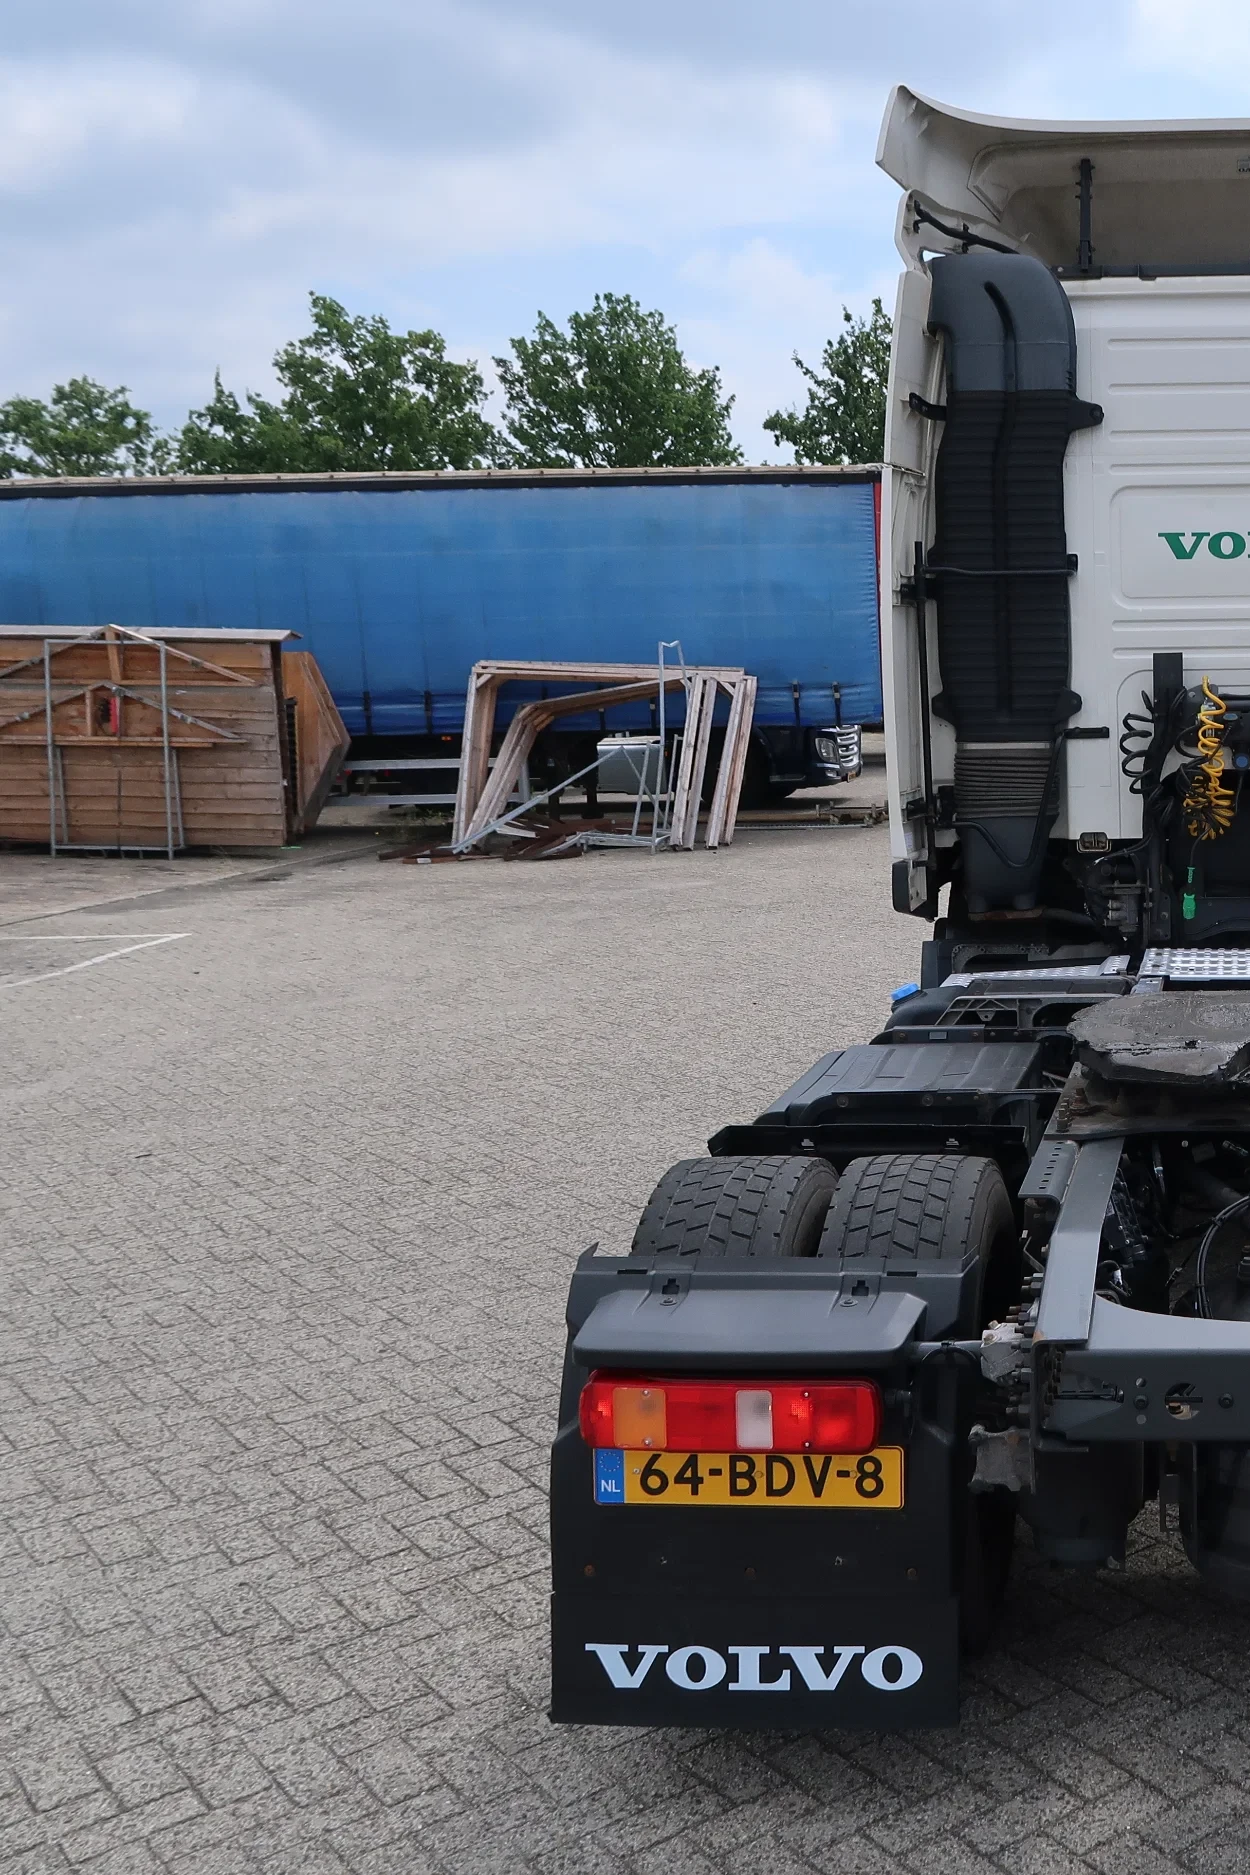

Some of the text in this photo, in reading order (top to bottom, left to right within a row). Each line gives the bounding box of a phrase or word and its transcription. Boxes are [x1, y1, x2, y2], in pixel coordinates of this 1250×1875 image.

[601, 1479, 621, 1493] NL
[639, 1453, 884, 1498] 64-BDV-8
[584, 1643, 923, 1691] VOLVO
